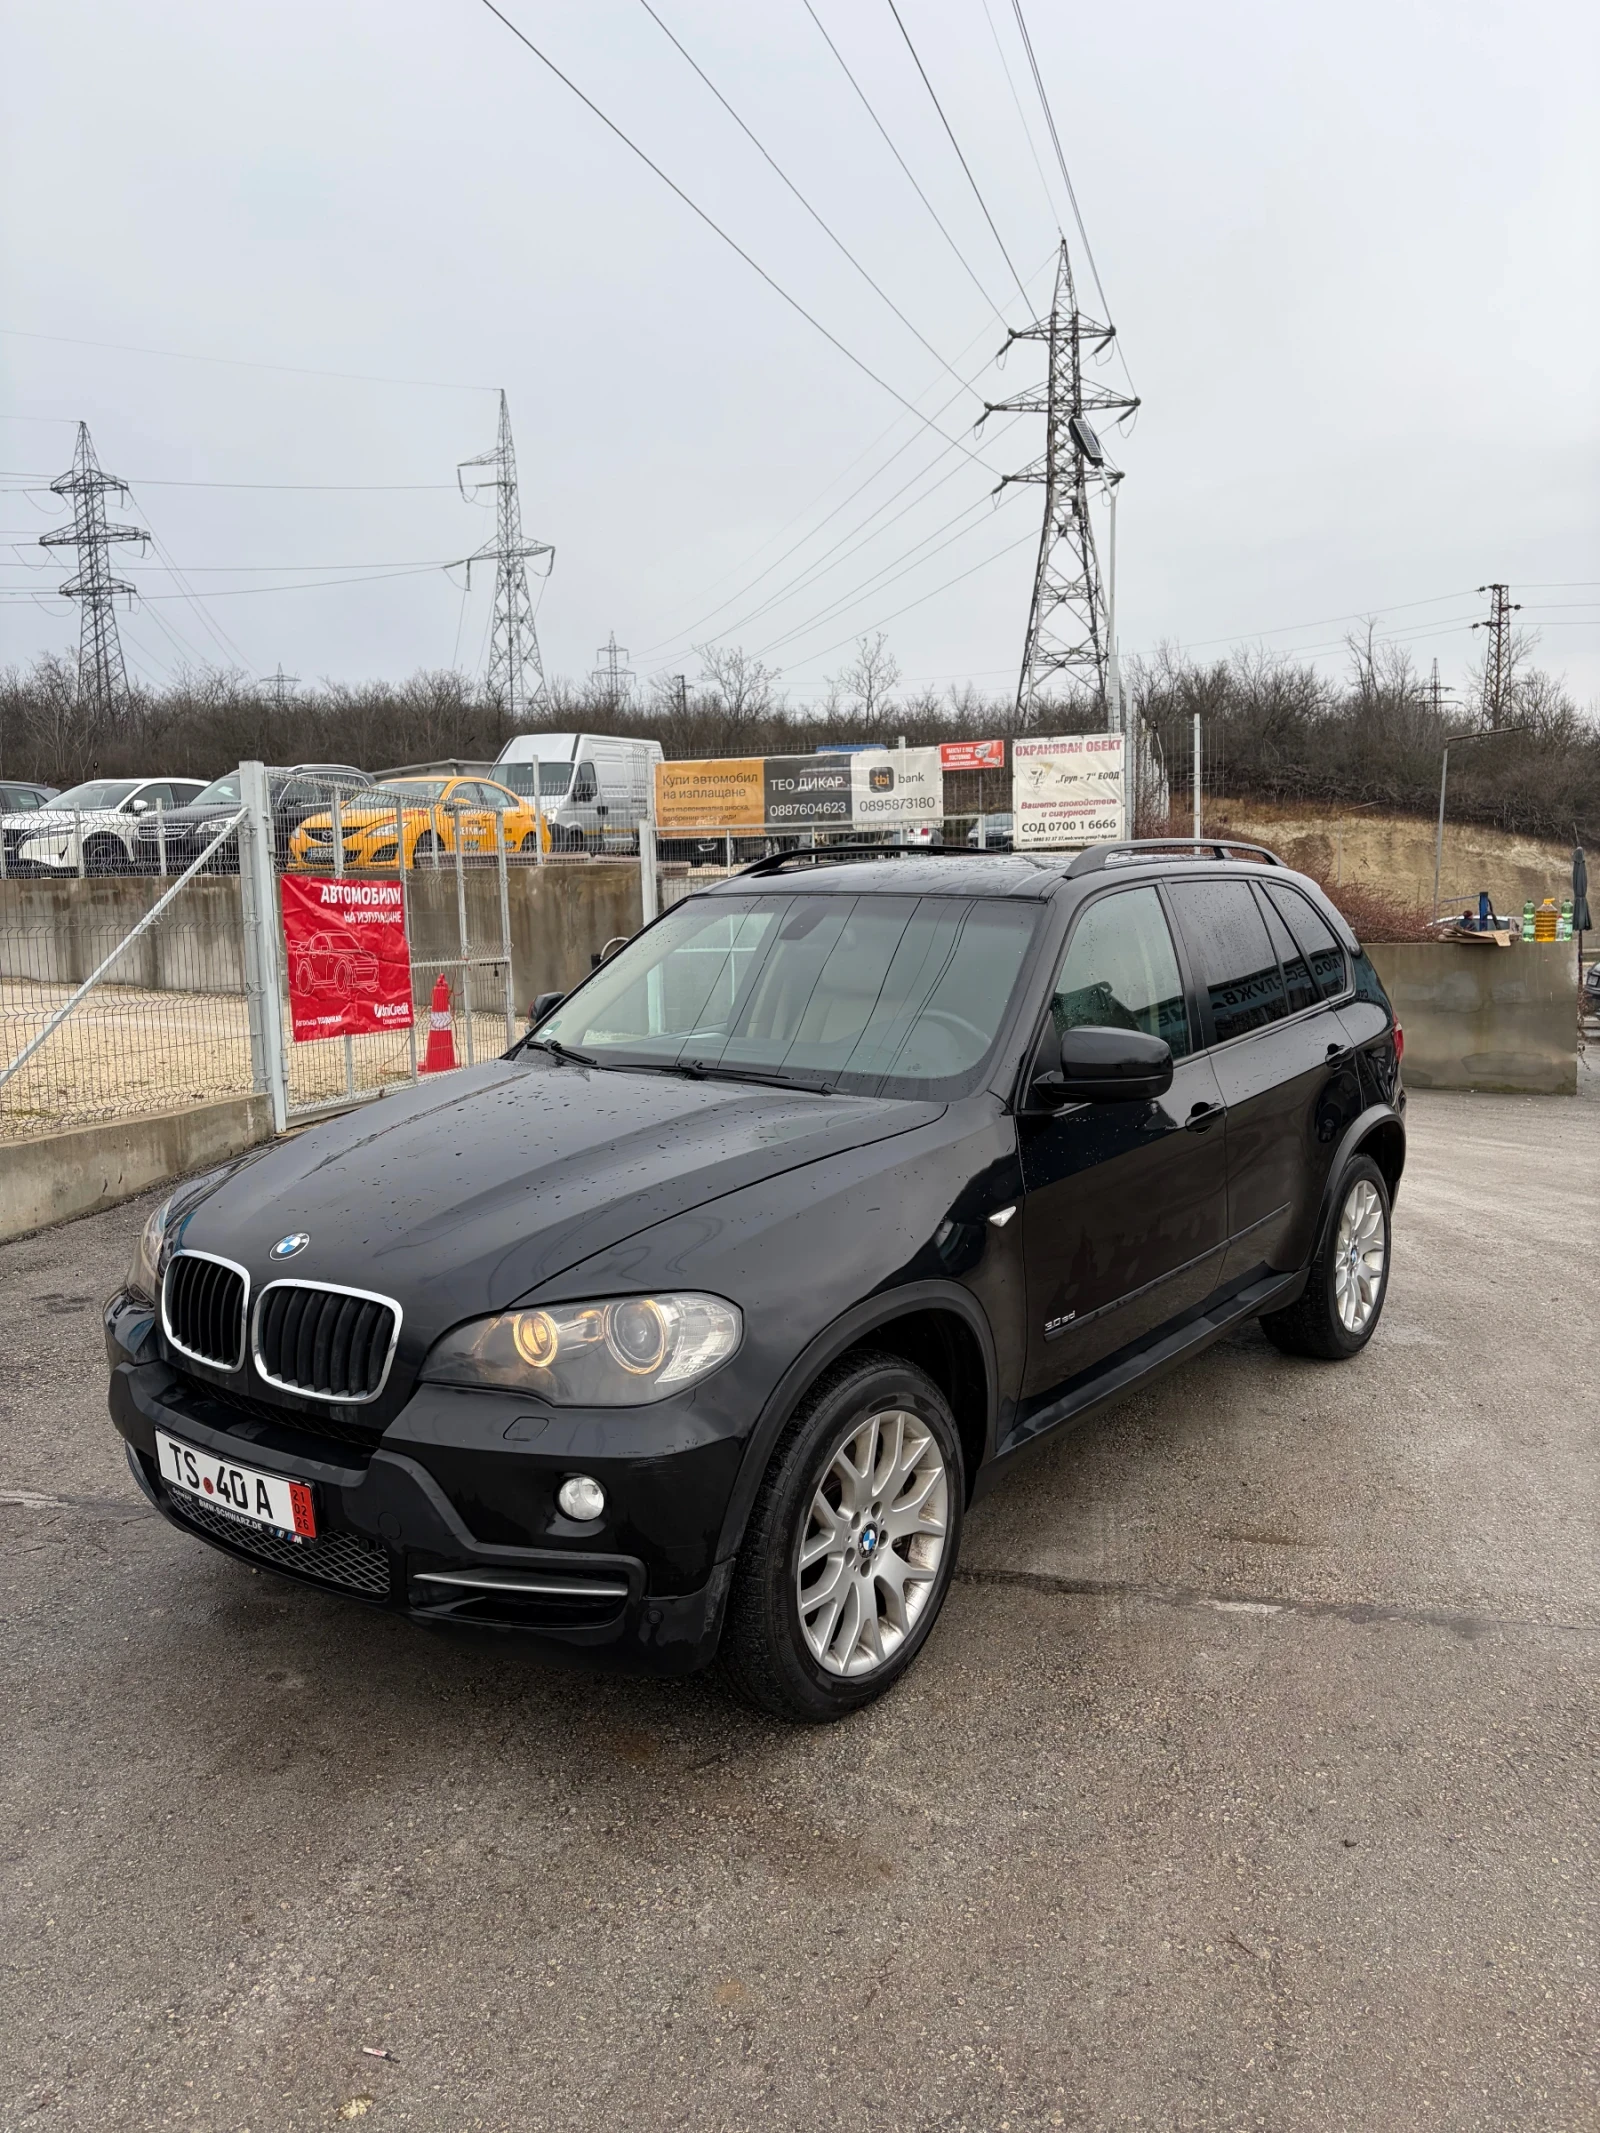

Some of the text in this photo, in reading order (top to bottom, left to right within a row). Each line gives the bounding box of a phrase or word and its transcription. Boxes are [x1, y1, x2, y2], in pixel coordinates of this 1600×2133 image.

[1015, 739, 1122, 757] ОХРАНЯВАН ОБЕКТ
[662, 772, 758, 786] Купи автомобил
[874, 772, 925, 787] tbi bank
[1098, 771, 1119, 780] ЕООД
[770, 776, 844, 791] ТЕО ДИКАР
[663, 787, 746, 800] на изплащане
[770, 802, 847, 817] 0887604623
[860, 797, 936, 812] 0895873180
[1021, 798, 1117, 810] Вашето спокойствие
[1049, 810, 1097, 819] сигурност
[1022, 822, 1046, 834] СОД
[1048, 821, 1076, 831] 0700
[1088, 819, 1117, 829] 6666
[321, 885, 402, 905] АВТОМОБИЛИ
[343, 911, 402, 924] НА ИЗПЛАЩАНЕ
[169, 1442, 274, 1520] TS 40 A
[292, 1490, 305, 1503] 21
[198, 1499, 263, 1532] BMW-SCHWARZ.DE
[294, 1504, 308, 1518] 02
[296, 1517, 309, 1531] 26
